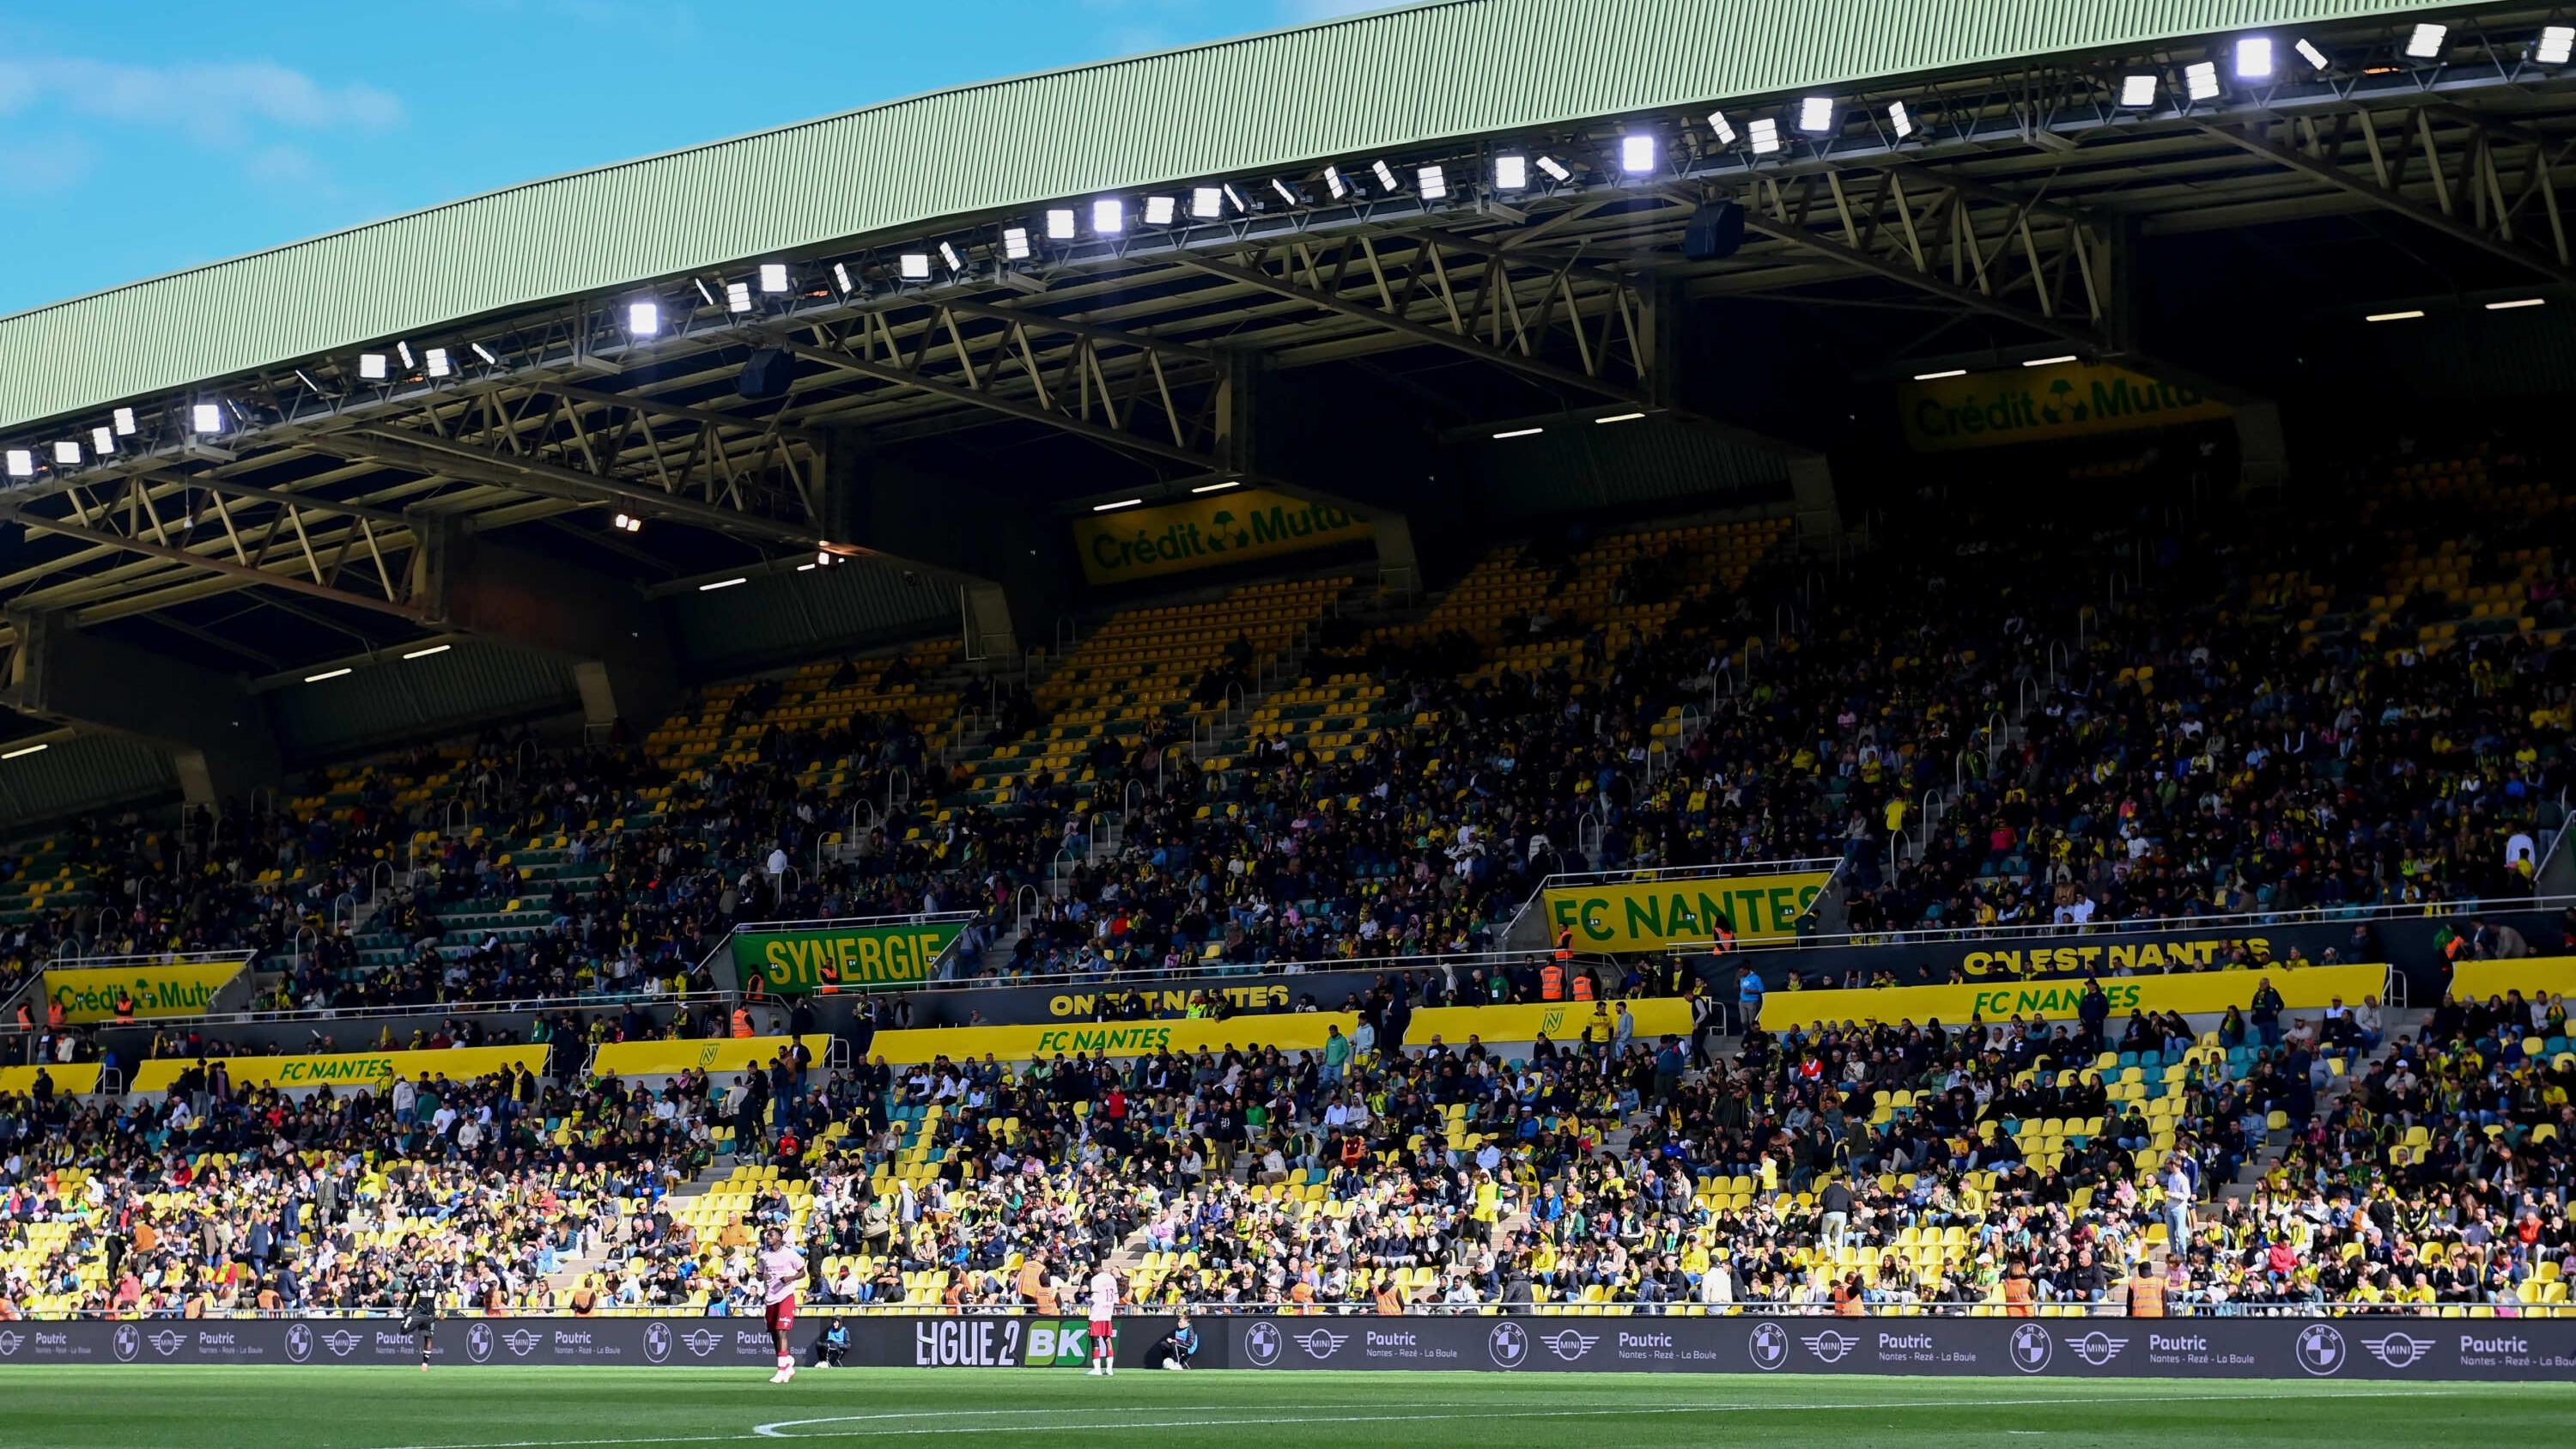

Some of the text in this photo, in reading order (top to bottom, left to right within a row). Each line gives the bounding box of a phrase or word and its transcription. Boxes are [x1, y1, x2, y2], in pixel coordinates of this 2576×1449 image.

[1093, 523, 1206, 569] Crédit
[1554, 898, 1615, 941] FC
[765, 934, 942, 985] SYNERGIE
[1963, 938, 2270, 976] ON EST NANTS
[1049, 994, 1095, 1016] ON
[1972, 985, 2142, 1014] FC NANES
[1038, 1027, 1170, 1051] FC NANTES
[279, 1058, 392, 1081] FC NANTES
[1105, 1288, 1115, 1303] 13
[36, 1332, 66, 1344] Pautric
[200, 1332, 234, 1344] Pautric
[377, 1332, 413, 1344] Pautric
[556, 1331, 591, 1344] Pautric
[695, 1338, 709, 1347] MINI
[998, 1320, 1020, 1366] 2
[1367, 1331, 1415, 1346] Pautric
[1559, 1340, 1580, 1349] MINI
[1619, 1332, 1672, 1348] Pautric
[1879, 1333, 1932, 1349] Pautric
[2149, 1335, 2206, 1351] Pautric
[2460, 1336, 2528, 1353] Pautric
[1367, 1349, 1393, 1357] Nantes
[1425, 1349, 1434, 1358] La
[1436, 1349, 1457, 1358] Baule
[1820, 1342, 1840, 1351] MINI
[2087, 1343, 2107, 1353] MINI
[2385, 1345, 2410, 1355] MINI
[1619, 1350, 1647, 1360] Nantes
[1681, 1350, 1692, 1360] La
[1693, 1350, 1716, 1360] Baule
[1879, 1352, 1906, 1361] Nantes
[1941, 1353, 1951, 1361] La
[1953, 1352, 1977, 1362] Baule
[2149, 1354, 2255, 1364] Nantes Rezé La Baule
[2460, 1355, 2496, 1367] Nantes
[2505, 1355, 2530, 1367] Rezé
[2540, 1356, 2552, 1367] La
